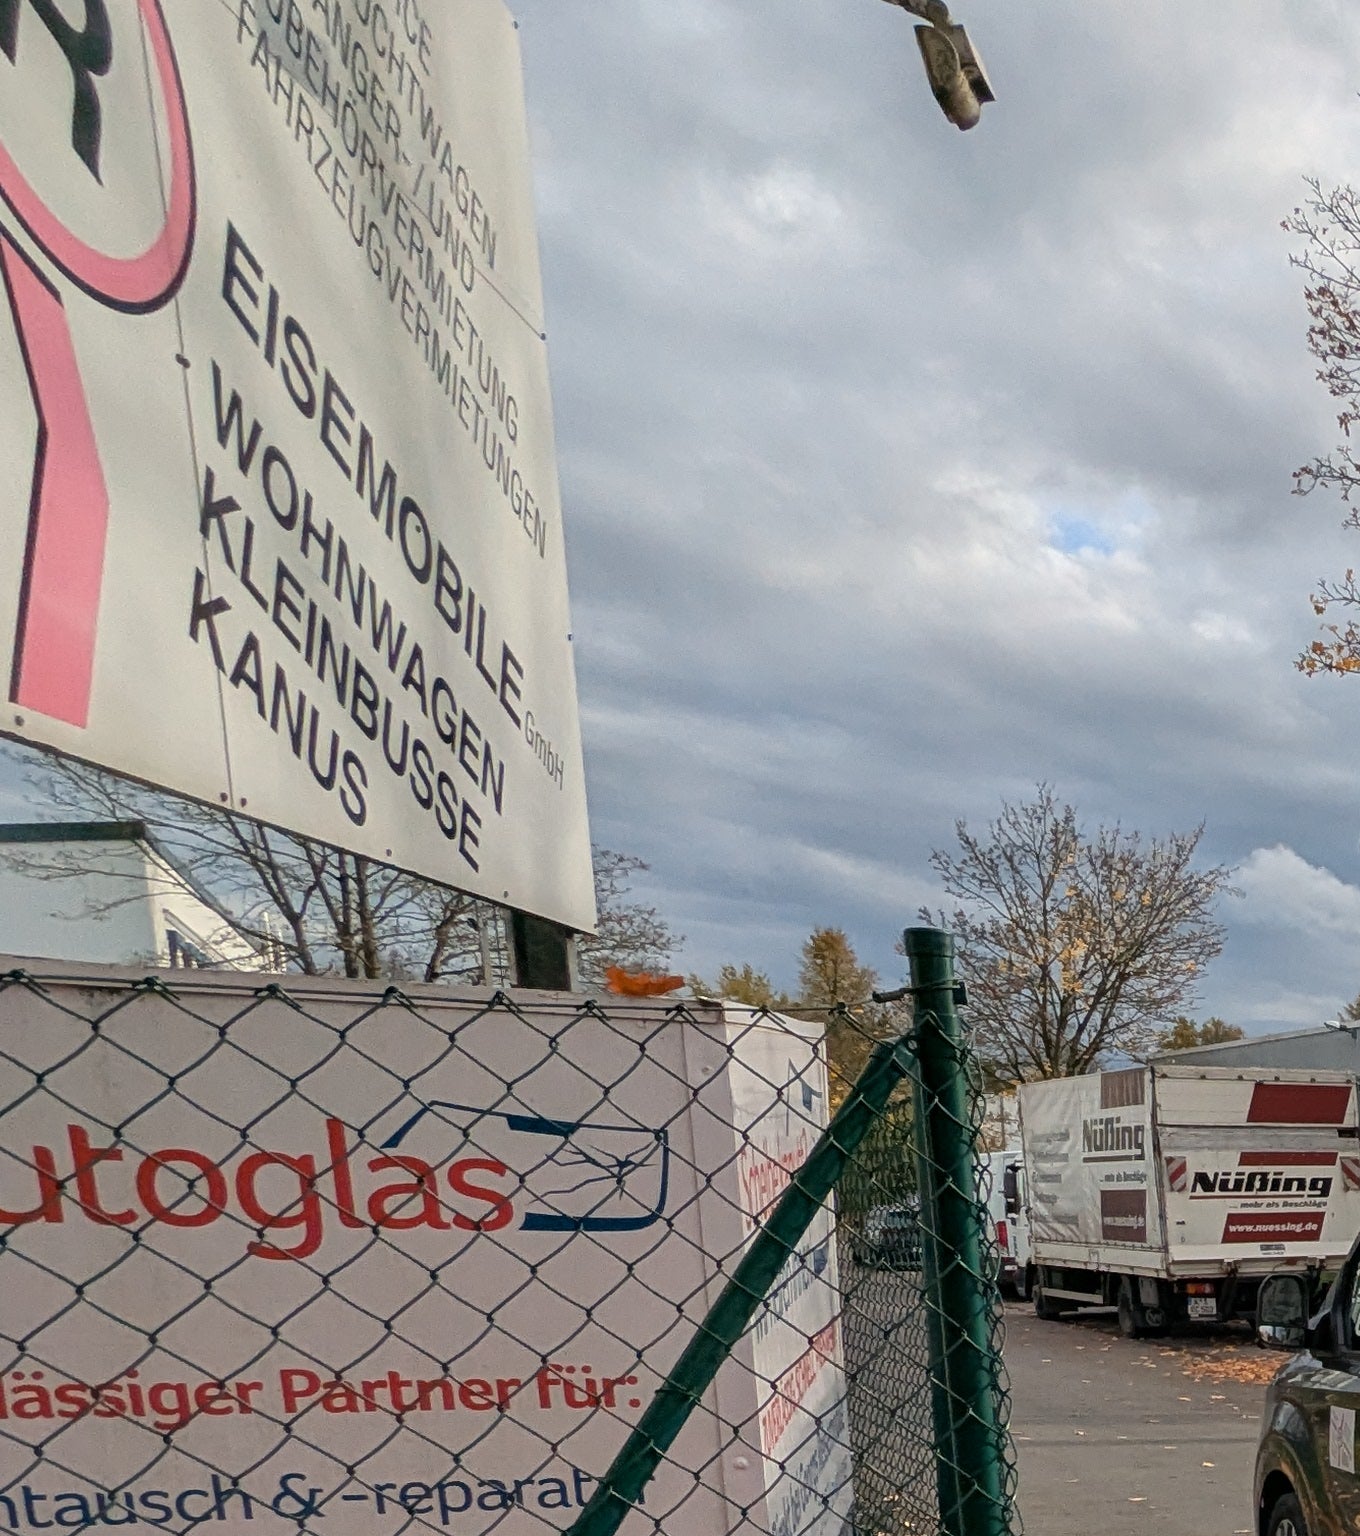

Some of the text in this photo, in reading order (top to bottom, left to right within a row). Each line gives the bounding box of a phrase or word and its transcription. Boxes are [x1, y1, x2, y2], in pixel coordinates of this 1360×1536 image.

[397, 0, 432, 76] CE
[237, 0, 546, 558] FAHRZEUGVERMIETUNGEN
[427, 182, 475, 292] UND
[222, 218, 564, 791] EISEMOBILE GmbH
[211, 358, 505, 816] WOHNWAGEN
[189, 566, 367, 826] KANUS
[199, 465, 482, 872] KLEINBUSSE
[0, 1117, 514, 1261] utoglas
[1082, 1116, 1145, 1161] Nüßing
[1190, 1171, 1333, 1198] Nüßing
[1228, 1221, 1318, 1234] www.nuessing.de
[279, 1368, 521, 1414] Partner
[536, 1363, 641, 1410] für:
[272, 1473, 325, 1518] &
[342, 1468, 655, 1526] -reparat
